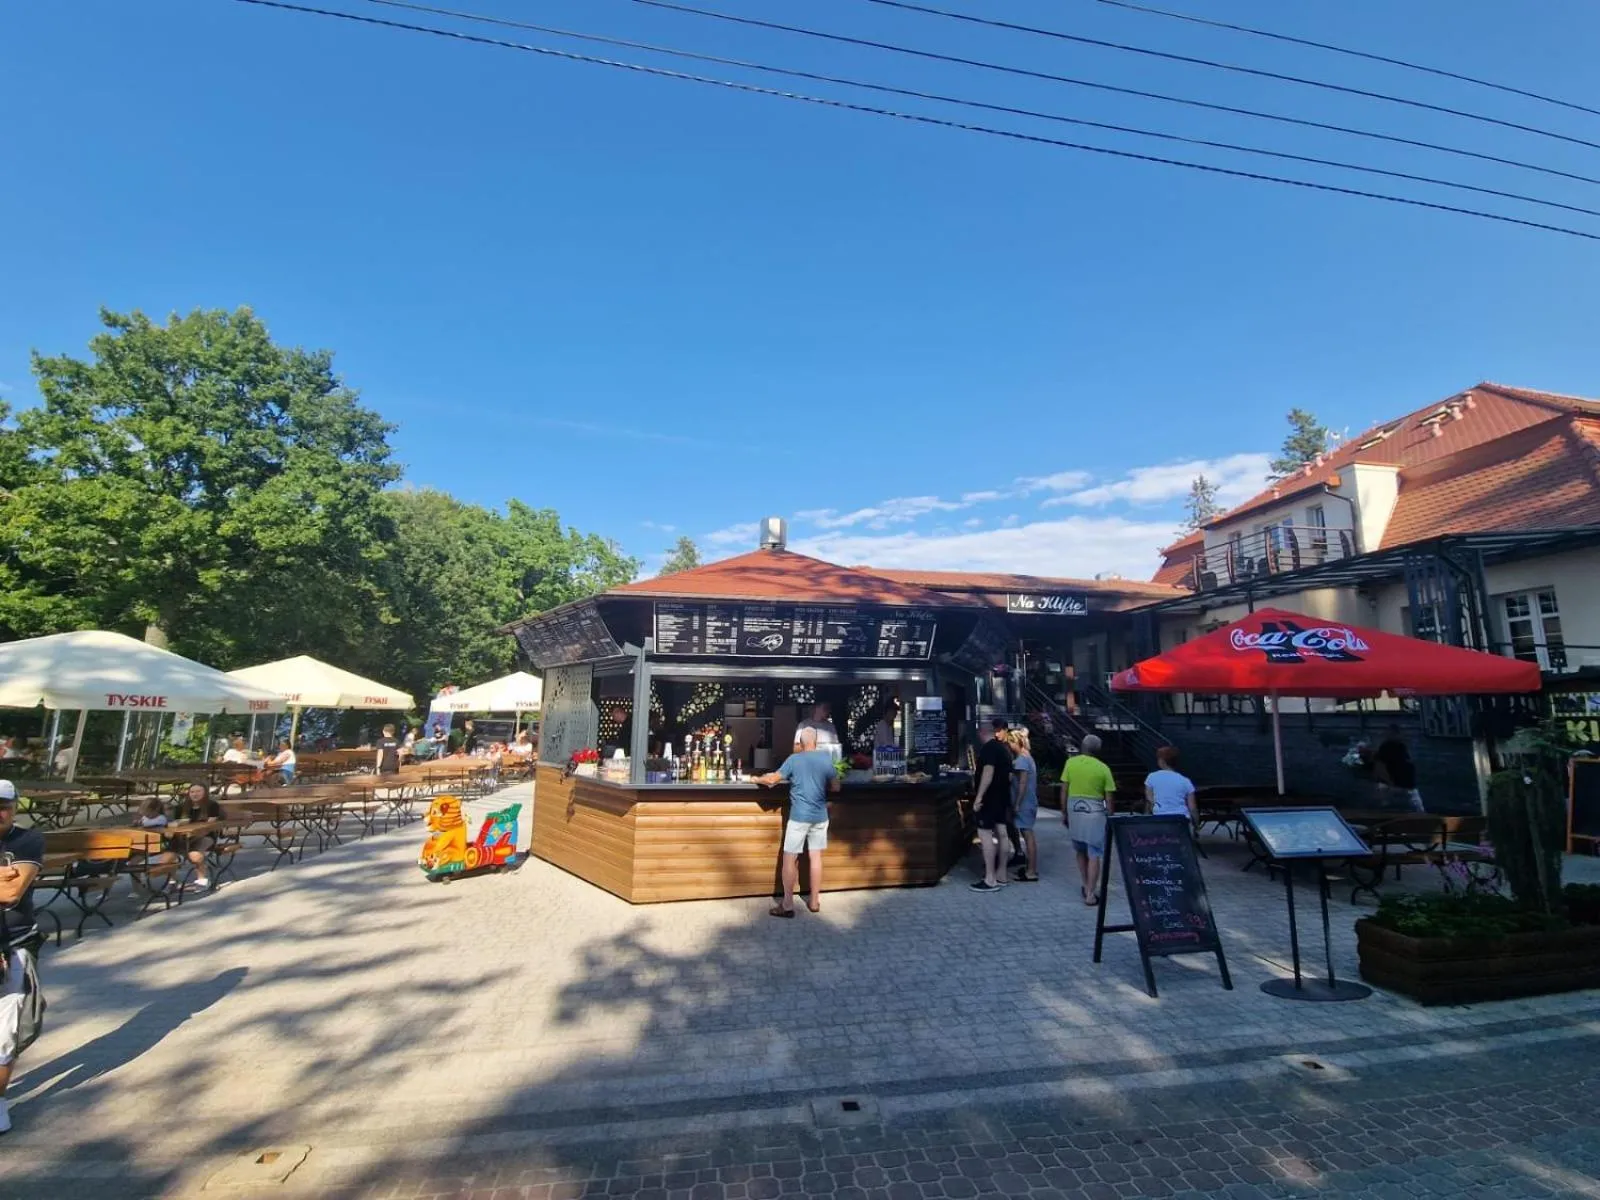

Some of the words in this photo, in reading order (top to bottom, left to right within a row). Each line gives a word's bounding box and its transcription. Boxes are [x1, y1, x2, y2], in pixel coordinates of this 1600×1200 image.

[1011, 594, 1035, 609] Na
[1038, 596, 1084, 615] Klifie
[105, 693, 168, 708] TYSKIE
[248, 700, 270, 711] TYSKIE
